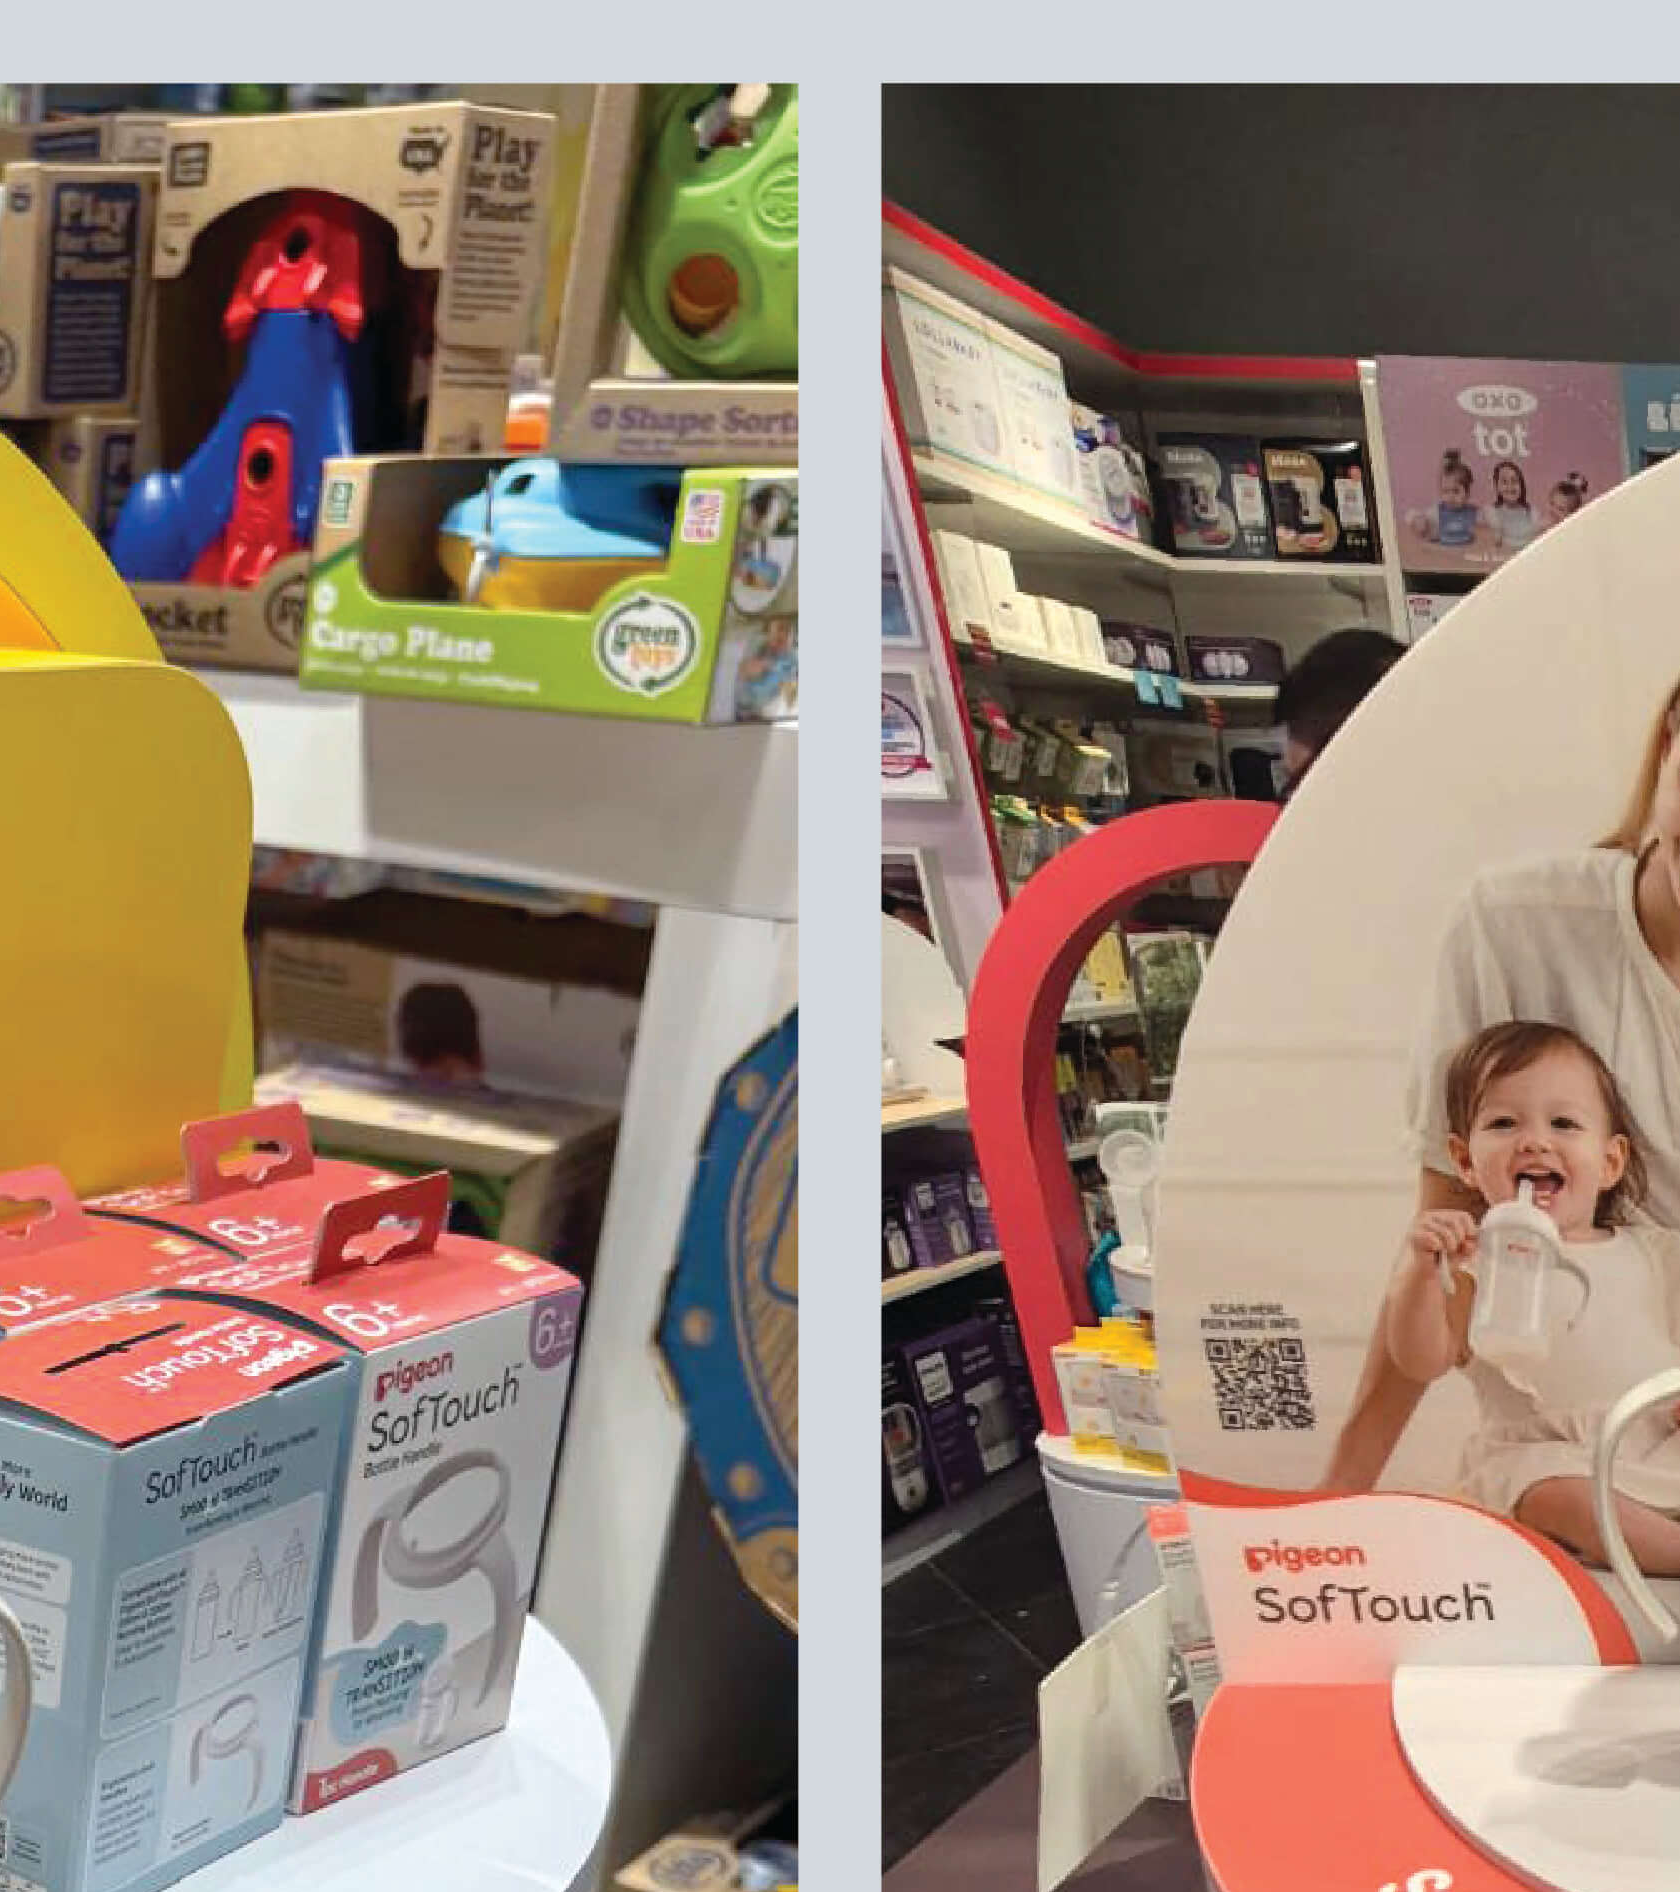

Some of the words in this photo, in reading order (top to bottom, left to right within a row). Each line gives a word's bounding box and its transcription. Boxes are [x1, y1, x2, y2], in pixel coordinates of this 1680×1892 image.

[473, 126, 541, 168] Play
[500, 165, 531, 190] the
[619, 402, 714, 434] Shape
[1471, 421, 1532, 458] tot
[141, 602, 231, 636] ocket
[616, 620, 680, 652] green
[310, 621, 396, 662] Cargo
[406, 626, 494, 664] Plane
[628, 642, 678, 672] toys
[322, 1302, 403, 1338] 6+
[534, 1310, 574, 1354] 6+
[374, 1351, 454, 1402] pigeon
[19, 1482, 69, 1513] World
[1243, 1540, 1367, 1573] pigeon
